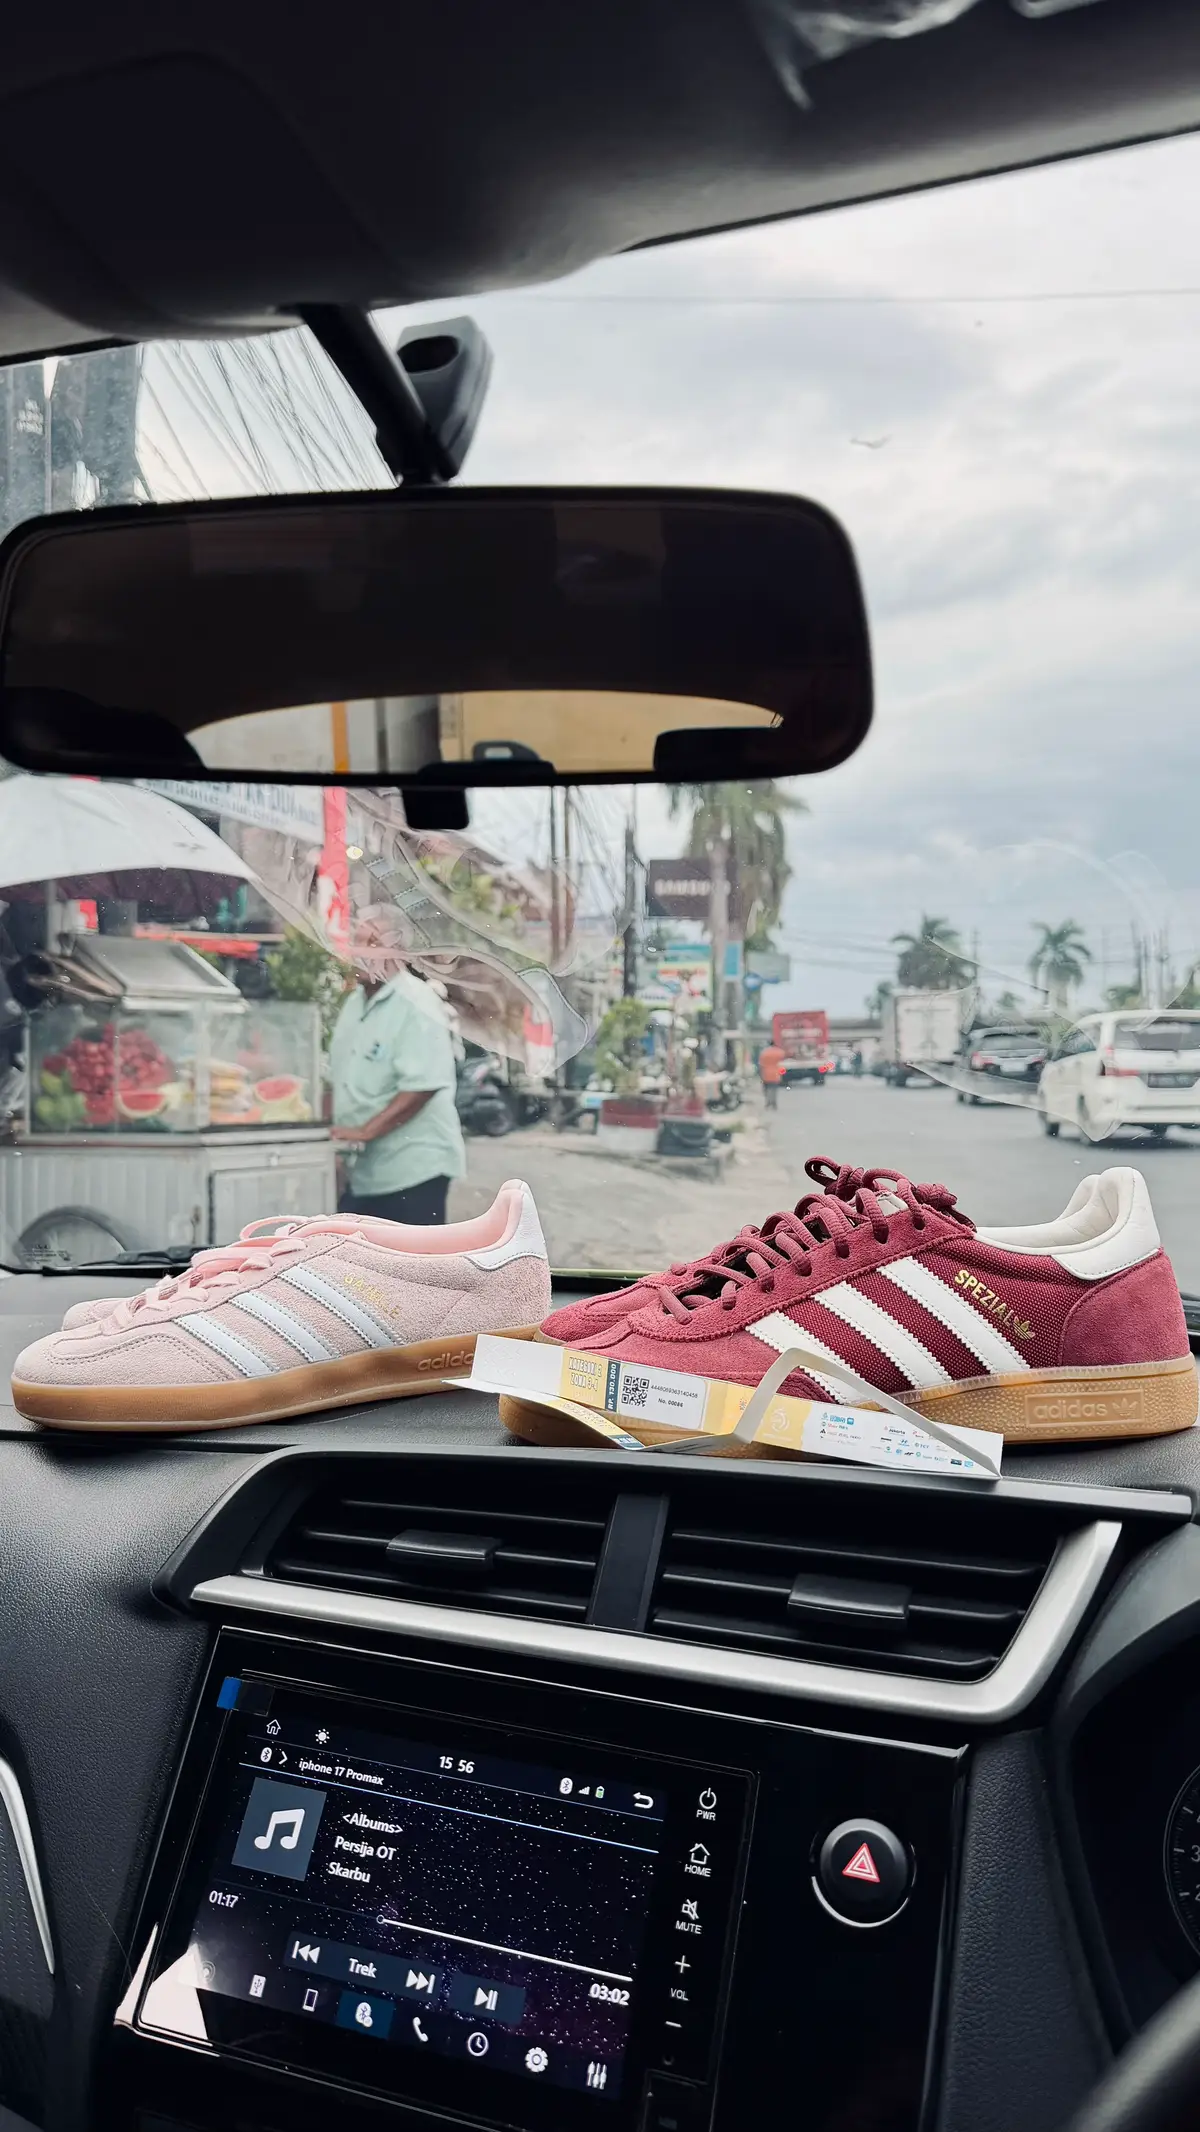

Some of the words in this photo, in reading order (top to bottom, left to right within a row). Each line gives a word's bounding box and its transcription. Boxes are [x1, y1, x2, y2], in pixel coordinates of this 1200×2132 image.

[954, 1269, 1015, 1326] SPEZIAL
[418, 1351, 474, 1371] adida
[608, 1363, 617, 1396] 130.000
[1033, 1399, 1108, 1420] adidas
[298, 1758, 332, 1775] iphone
[334, 1766, 344, 1777] 17
[346, 1769, 385, 1786] Promax
[439, 1755, 454, 1770] 15
[457, 1759, 476, 1774] 56
[342, 1812, 404, 1834] <Albums>
[696, 1809, 716, 1821] PWR
[335, 1836, 375, 1858] Persija
[376, 1846, 397, 1861] OT
[328, 1862, 371, 1883] Skarbu
[684, 1864, 711, 1878] HOME
[208, 1890, 239, 1908] 01:17
[675, 1920, 702, 1934] MUTE
[348, 1958, 377, 1979] Trek
[588, 1982, 631, 2007] 03:02
[670, 1988, 689, 2001] VOL
